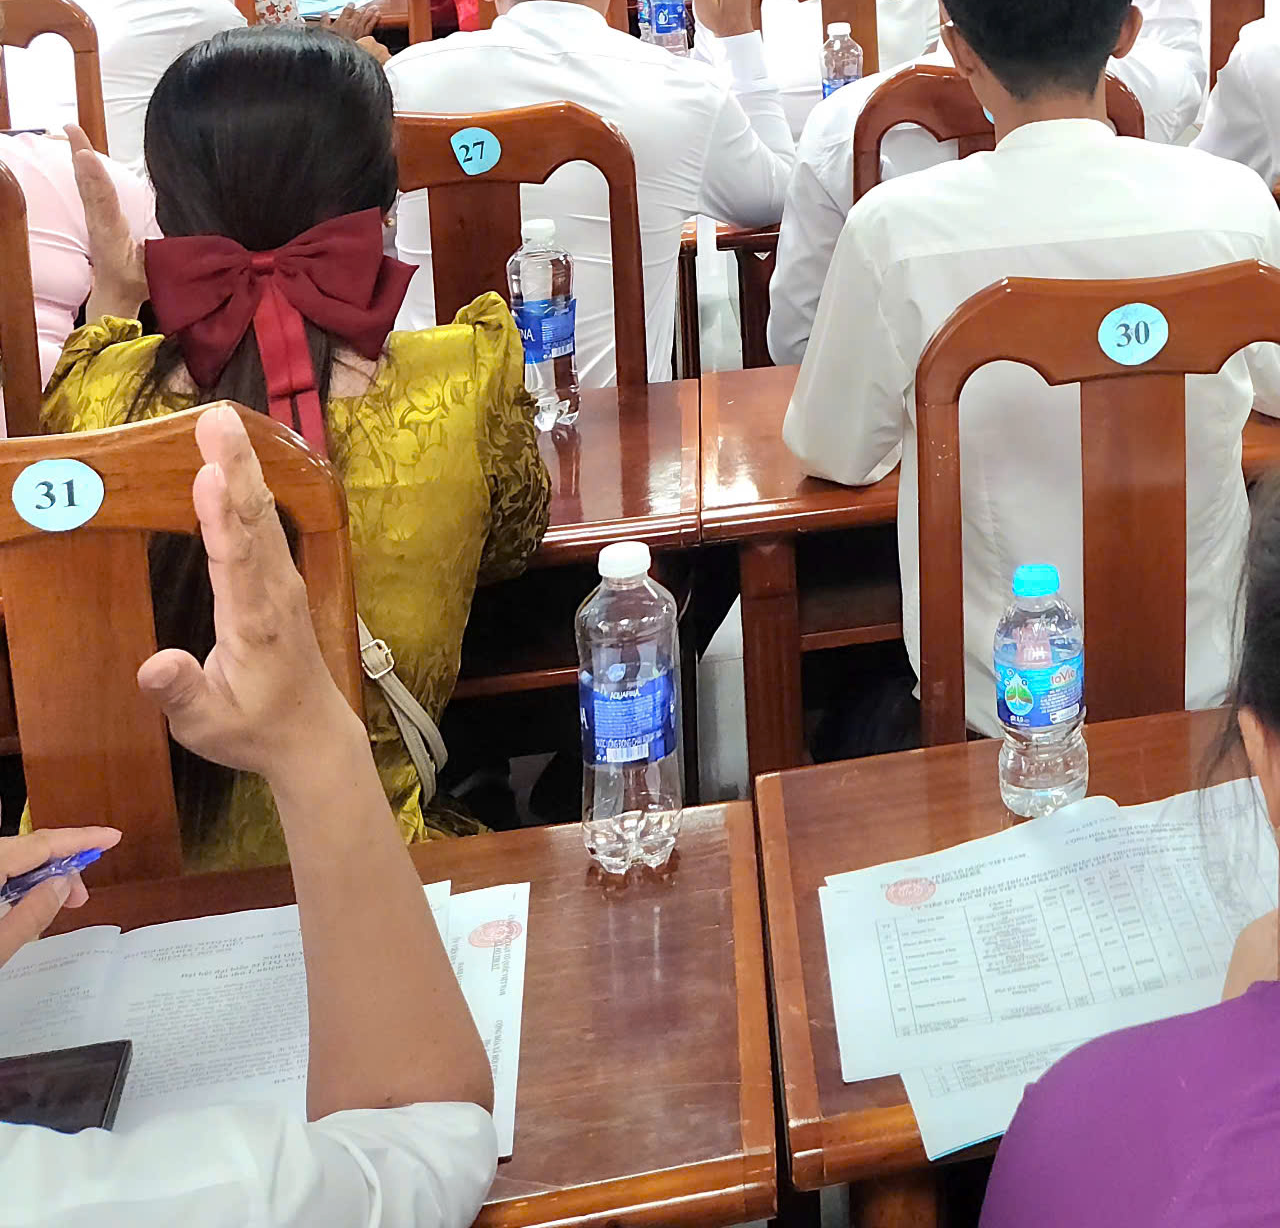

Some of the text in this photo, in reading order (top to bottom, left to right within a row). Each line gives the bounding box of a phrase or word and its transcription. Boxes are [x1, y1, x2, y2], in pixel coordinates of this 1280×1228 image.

[459, 140, 487, 165] 27
[1116, 320, 1150, 349] 30
[34, 478, 79, 510] 31
